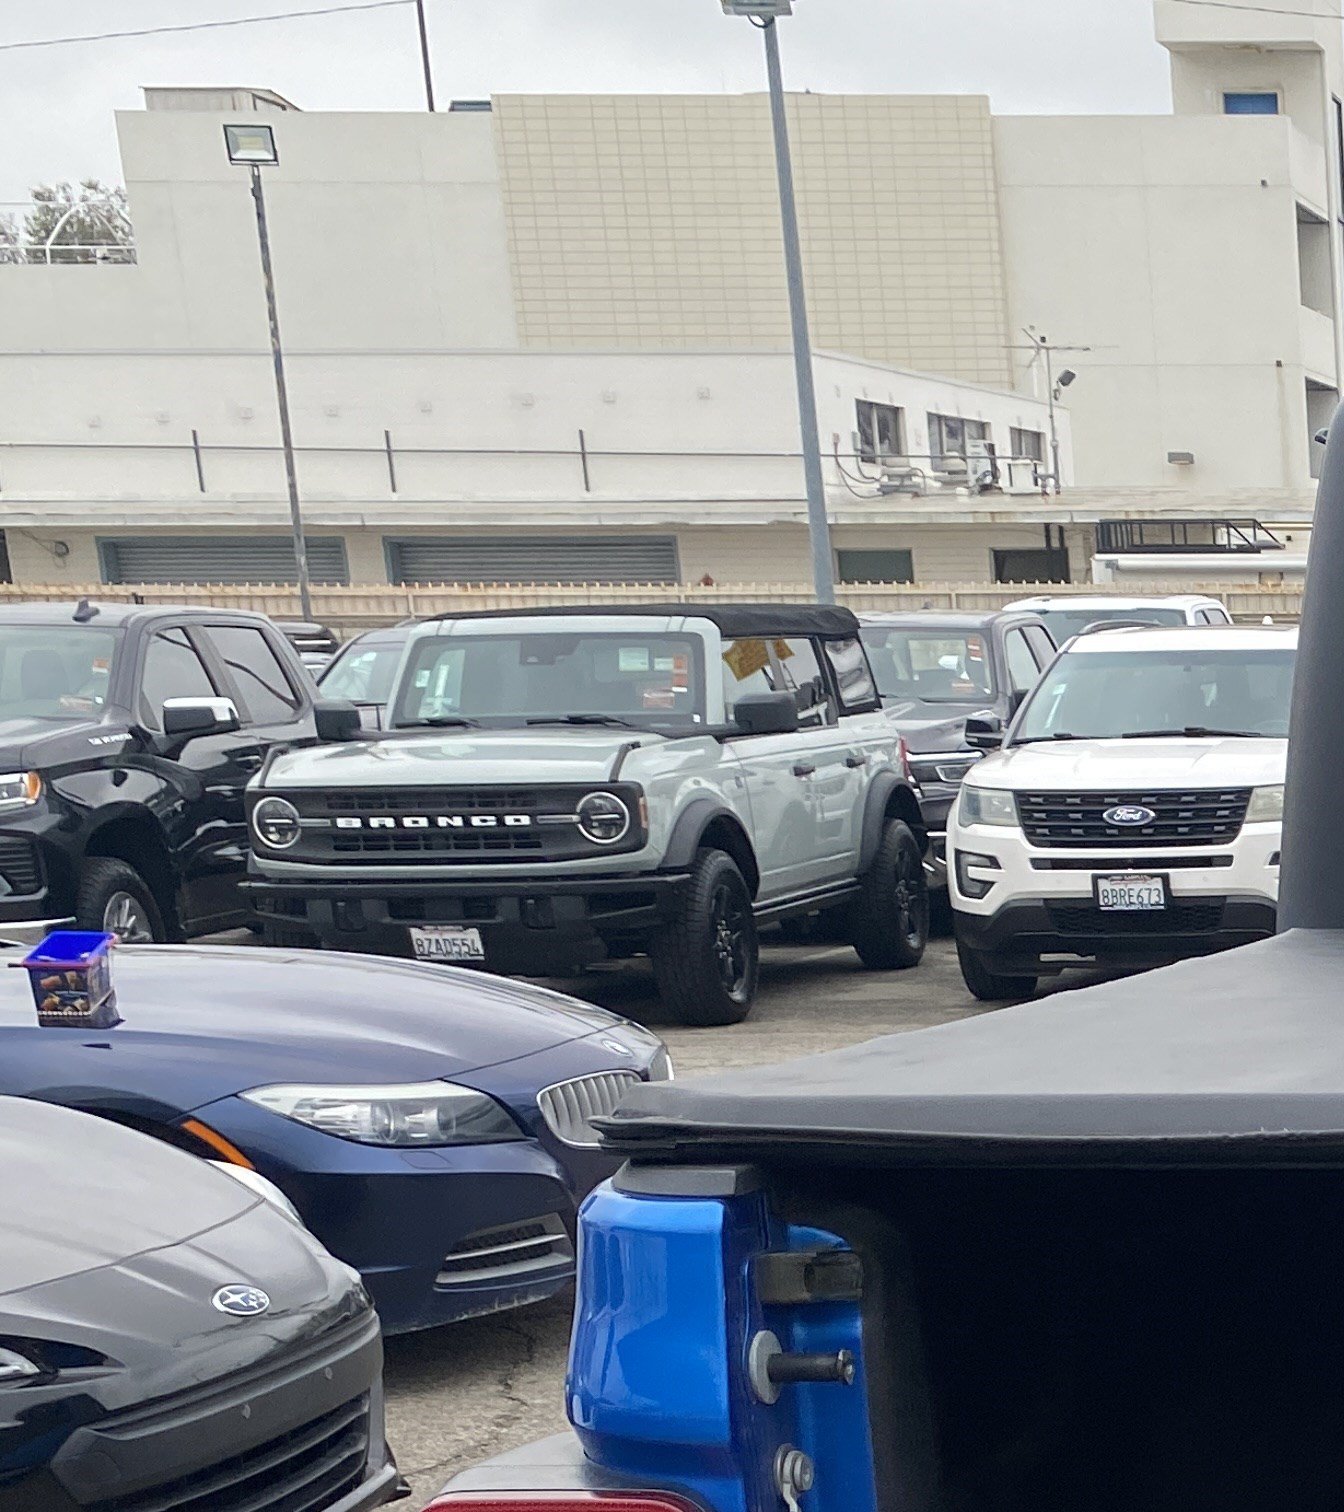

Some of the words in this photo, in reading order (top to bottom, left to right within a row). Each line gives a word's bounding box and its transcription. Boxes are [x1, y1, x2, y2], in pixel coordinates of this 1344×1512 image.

[1112, 808, 1143, 821] Ford
[336, 815, 532, 828] BRONCO
[1101, 888, 1161, 907] 8BRE673
